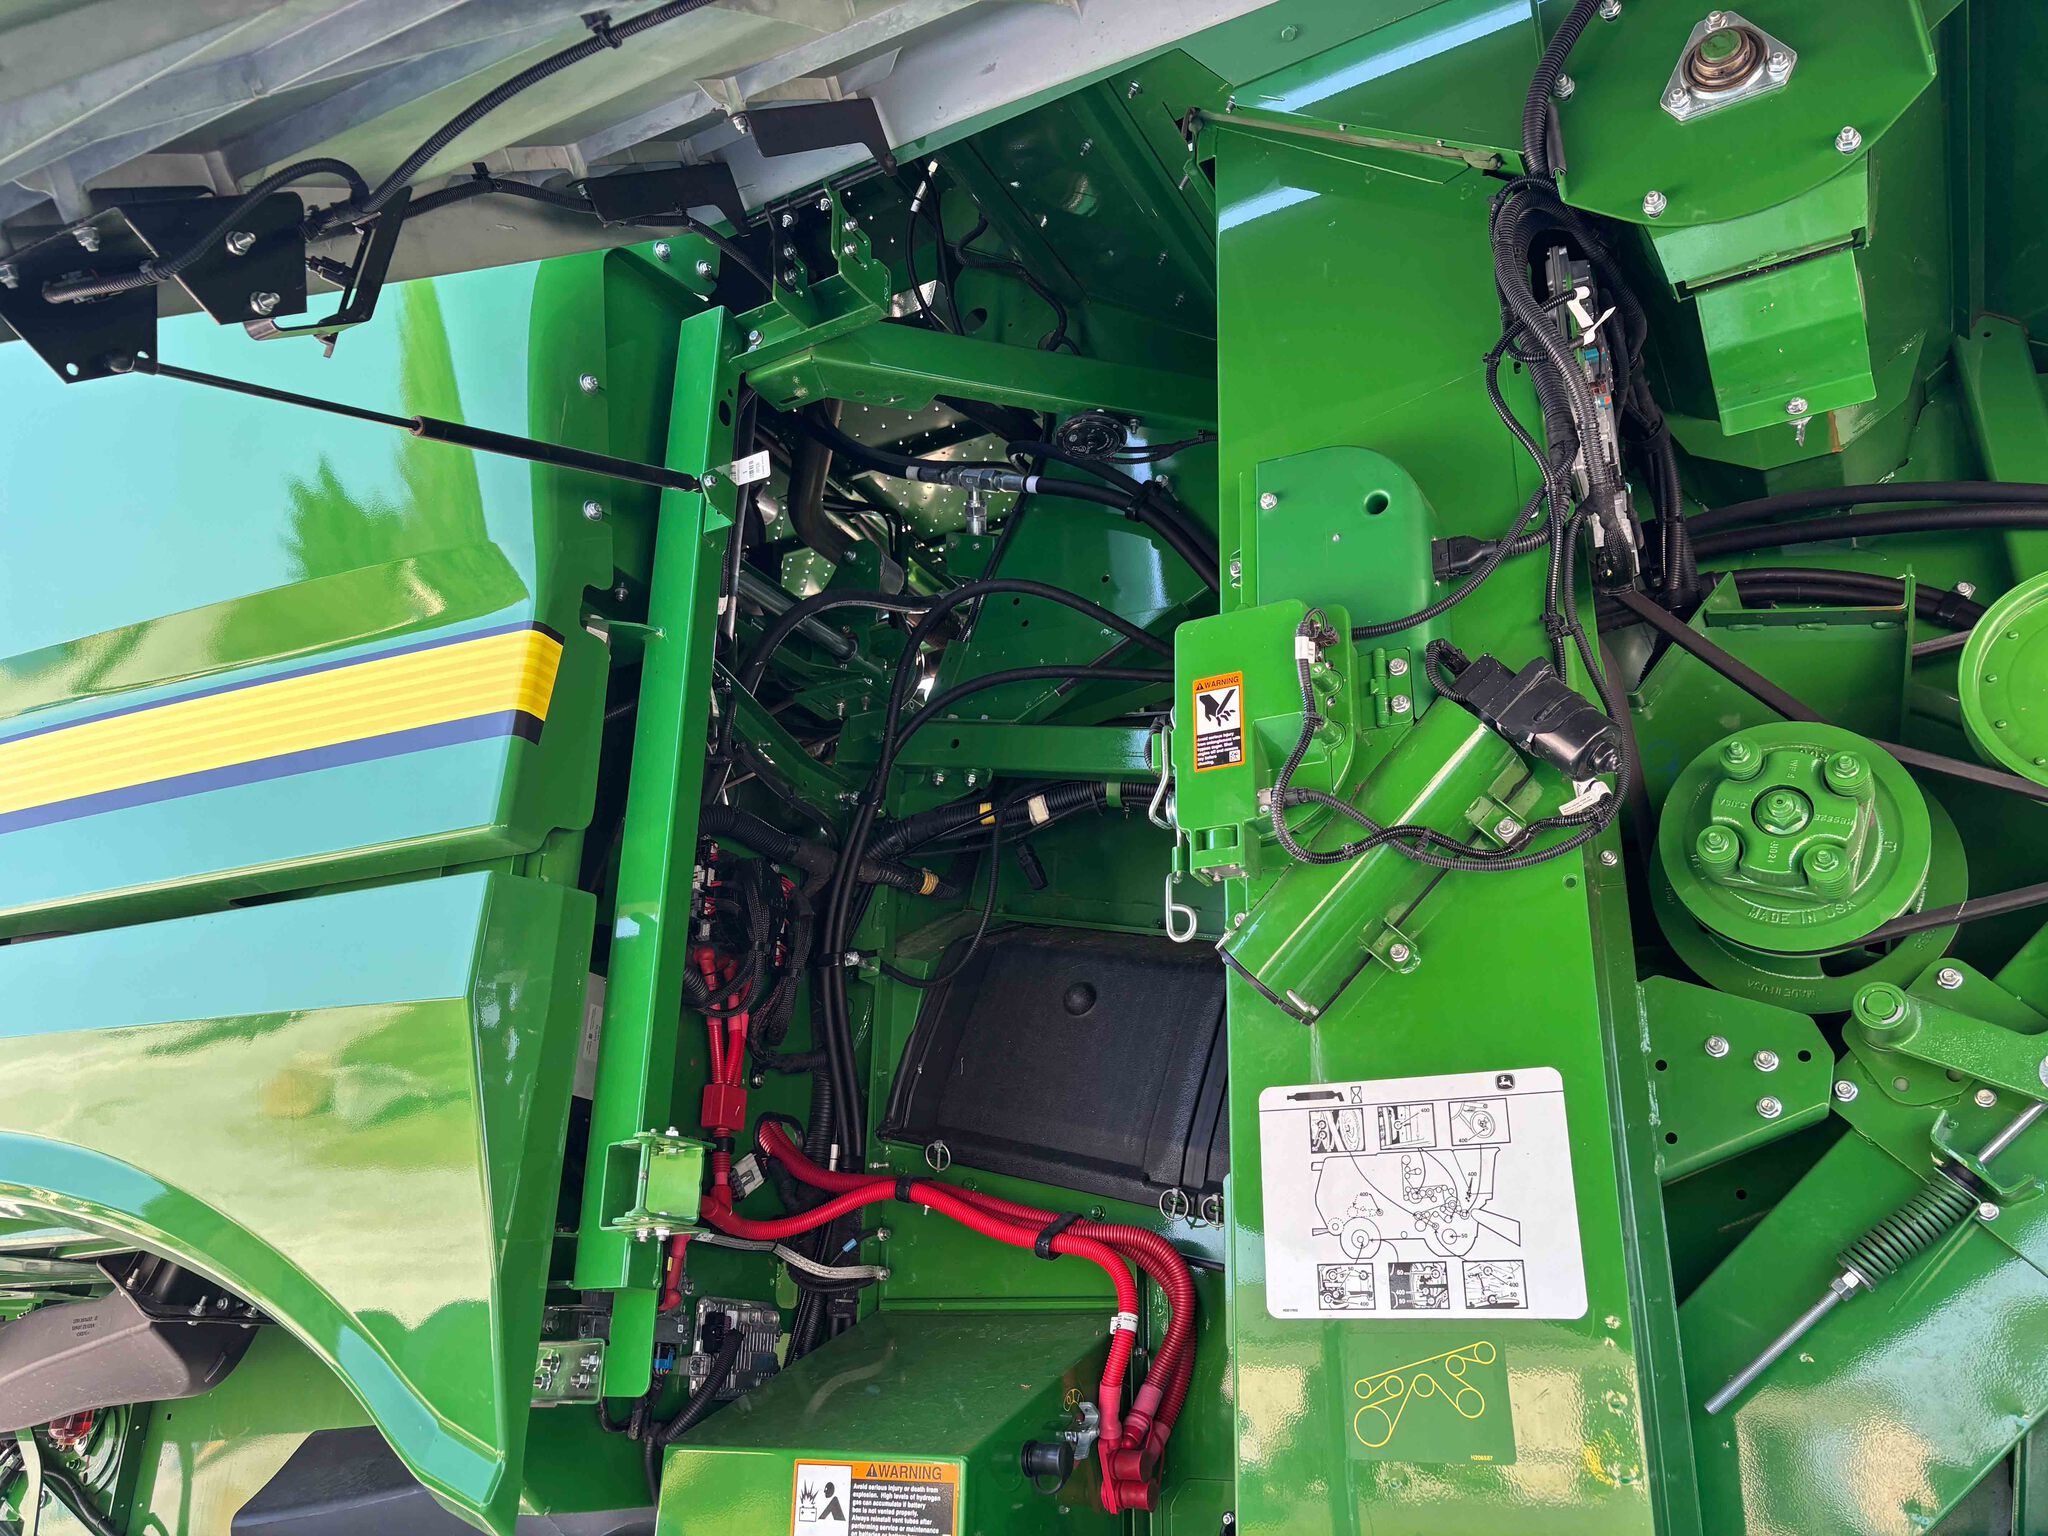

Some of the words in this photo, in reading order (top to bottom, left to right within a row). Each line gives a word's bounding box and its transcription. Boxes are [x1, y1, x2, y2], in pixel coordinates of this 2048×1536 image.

[1204, 676, 1239, 688] WARNING
[1747, 904, 1791, 925] MADE
[1800, 909, 1817, 924] IN
[1827, 899, 1857, 919] USA
[878, 1464, 942, 1480] WARNING
[853, 1482, 868, 1490] Avoid
[888, 1484, 903, 1493] injury
[911, 1485, 926, 1493] death
[926, 1486, 938, 1494] from
[852, 1491, 878, 1499] explosion.
[880, 1492, 893, 1500] High
[916, 1494, 941, 1503] hydrogen
[873, 1500, 902, 1508] accumulate
[907, 1501, 926, 1510] battery
[877, 1508, 895, 1516] vented
[895, 1509, 919, 1518] properly.
[851, 1515, 870, 1523] Always
[870, 1516, 891, 1524] reinstall
[904, 1517, 919, 1525] tubes
[919, 1518, 933, 1526] after
[851, 1523, 879, 1532] performing
[905, 1525, 940, 1534] maintenance
